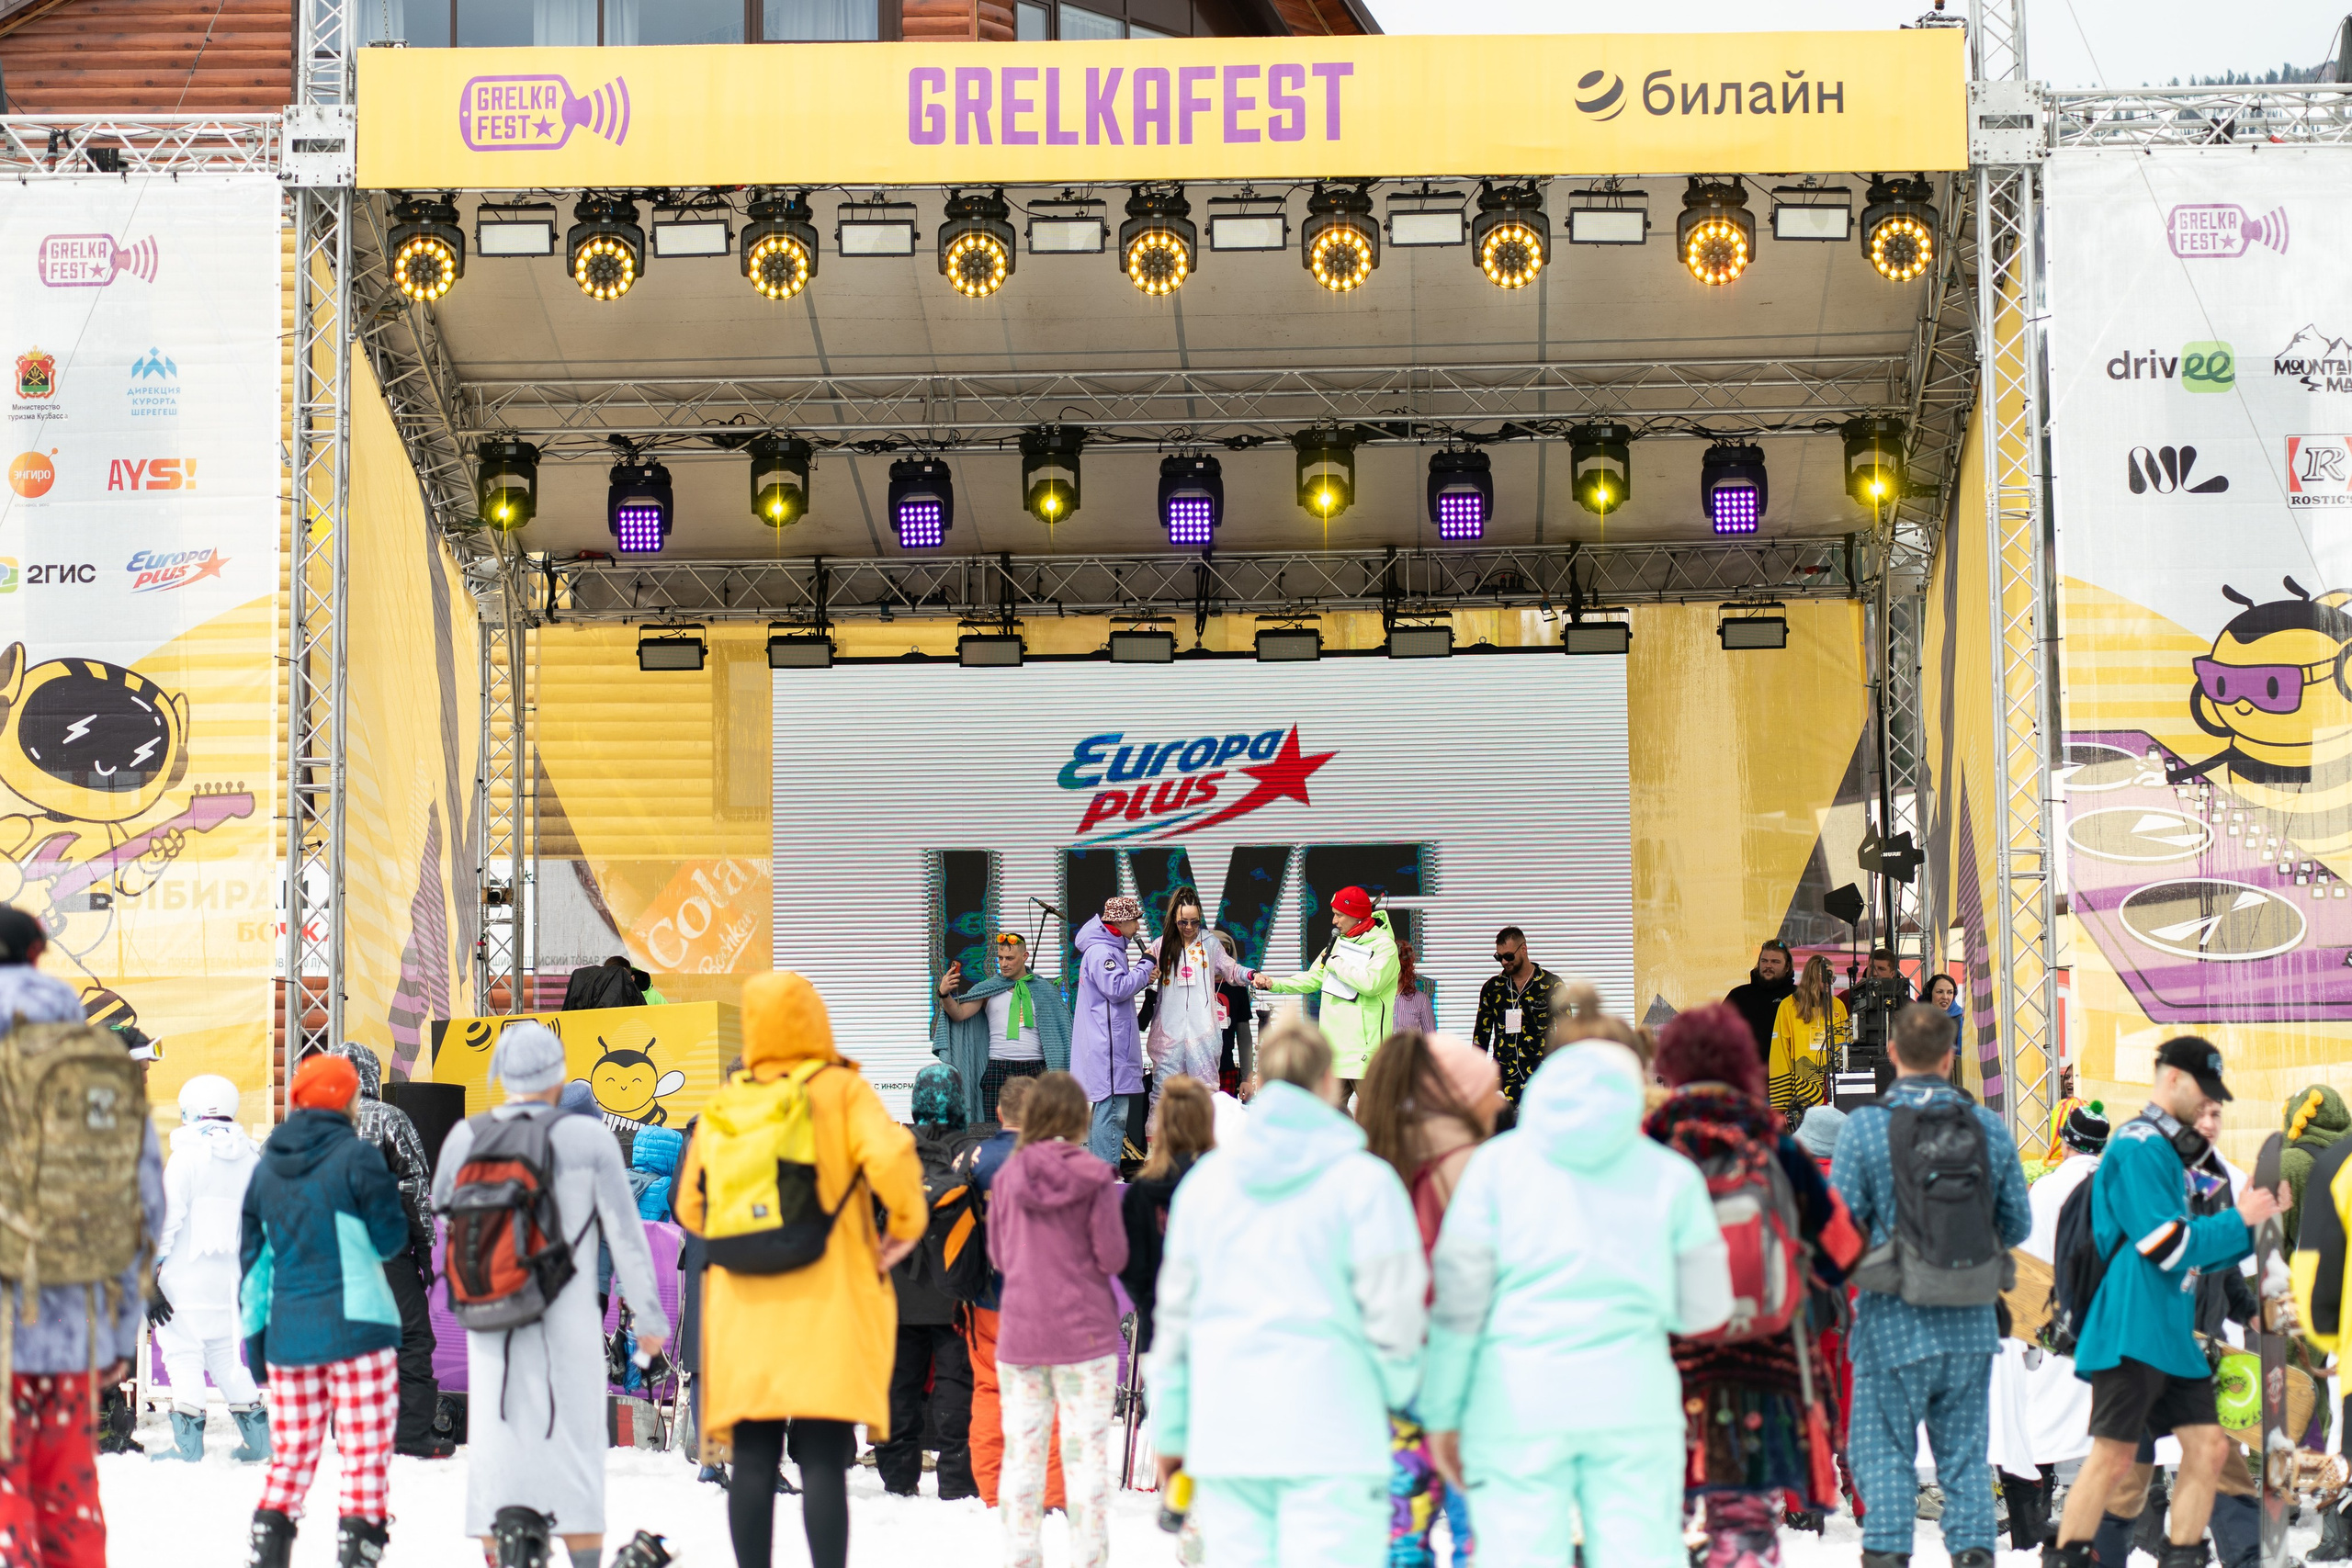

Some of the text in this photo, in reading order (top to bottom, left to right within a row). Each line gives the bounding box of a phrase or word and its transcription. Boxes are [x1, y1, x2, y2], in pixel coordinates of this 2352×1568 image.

[478, 85, 556, 110] GRELKA
[1642, 69, 1845, 116] билайн
[908, 62, 1354, 146] GRELKAFEST
[477, 115, 530, 140] FEST
[2179, 211, 2237, 231] GRELKA
[51, 241, 107, 260] GRELKA
[2180, 232, 2219, 251] FEST
[51, 262, 88, 279] FEST
[2106, 348, 2235, 384] drivee
[127, 387, 181, 396] ДИРЕКЦИЯ
[132, 397, 176, 406] КУРОРТА
[8, 412, 68, 422] туризма Кузбасса
[12, 403, 61, 412] Министерство
[131, 408, 177, 416] ШЕРЕГЕШ
[14, 469, 51, 482] энгиро
[107, 457, 198, 491] AYS!
[2129, 446, 2229, 494] NL
[126, 548, 213, 572] Europa
[27, 564, 96, 584] 2ГИС
[1057, 728, 1286, 790] Europa
[647, 858, 748, 969] Cola
[237, 920, 330, 943] БОЧК
[571, 954, 599, 965] ТОВАР
